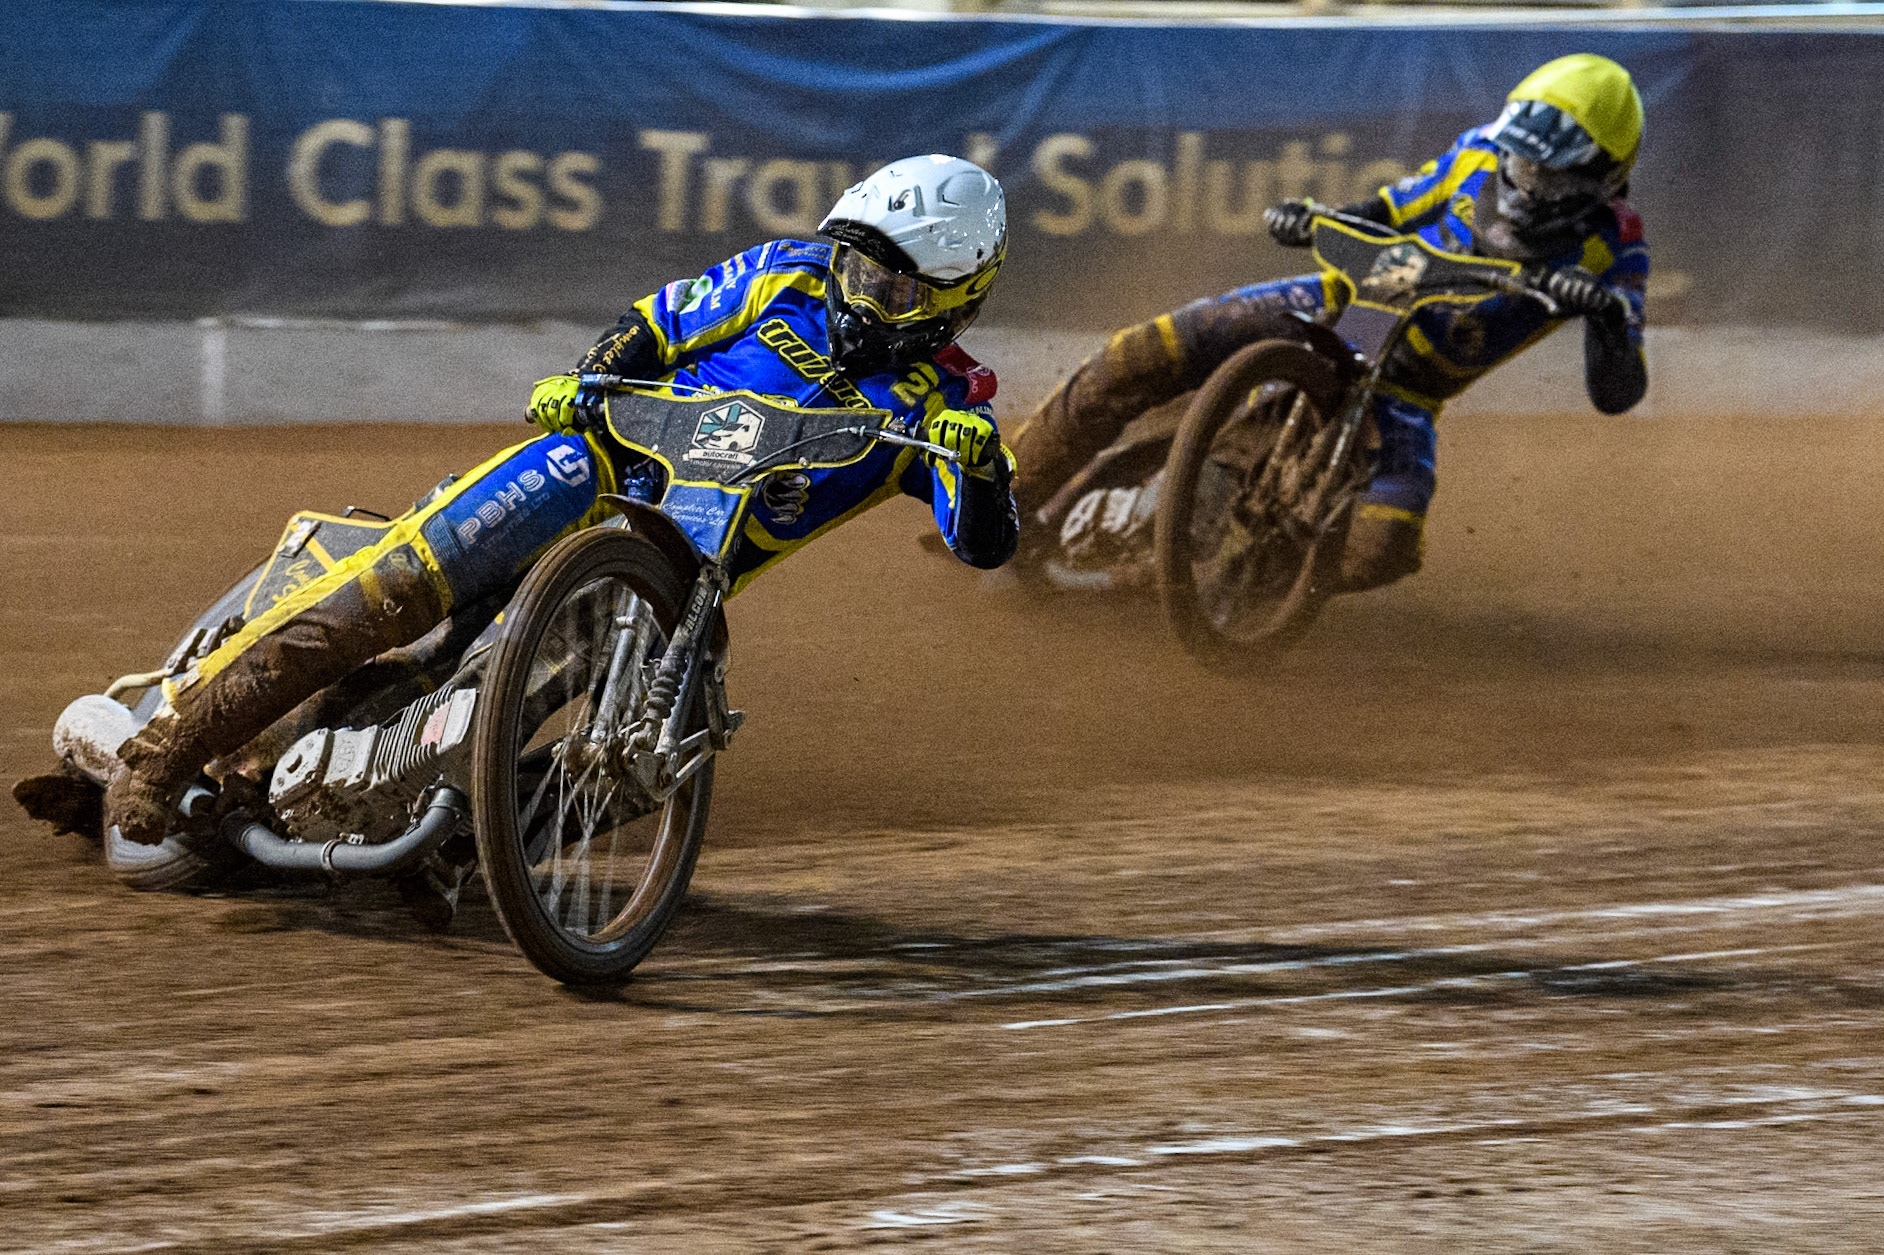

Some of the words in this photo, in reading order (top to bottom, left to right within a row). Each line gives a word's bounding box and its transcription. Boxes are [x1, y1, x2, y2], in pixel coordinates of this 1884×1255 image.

[0, 110, 250, 222] orld
[287, 117, 602, 232] Class
[637, 129, 999, 234] Tra
[702, 450, 739, 460] autocraft
[455, 469, 546, 545] PBHS
[684, 586, 707, 634] ALCON
